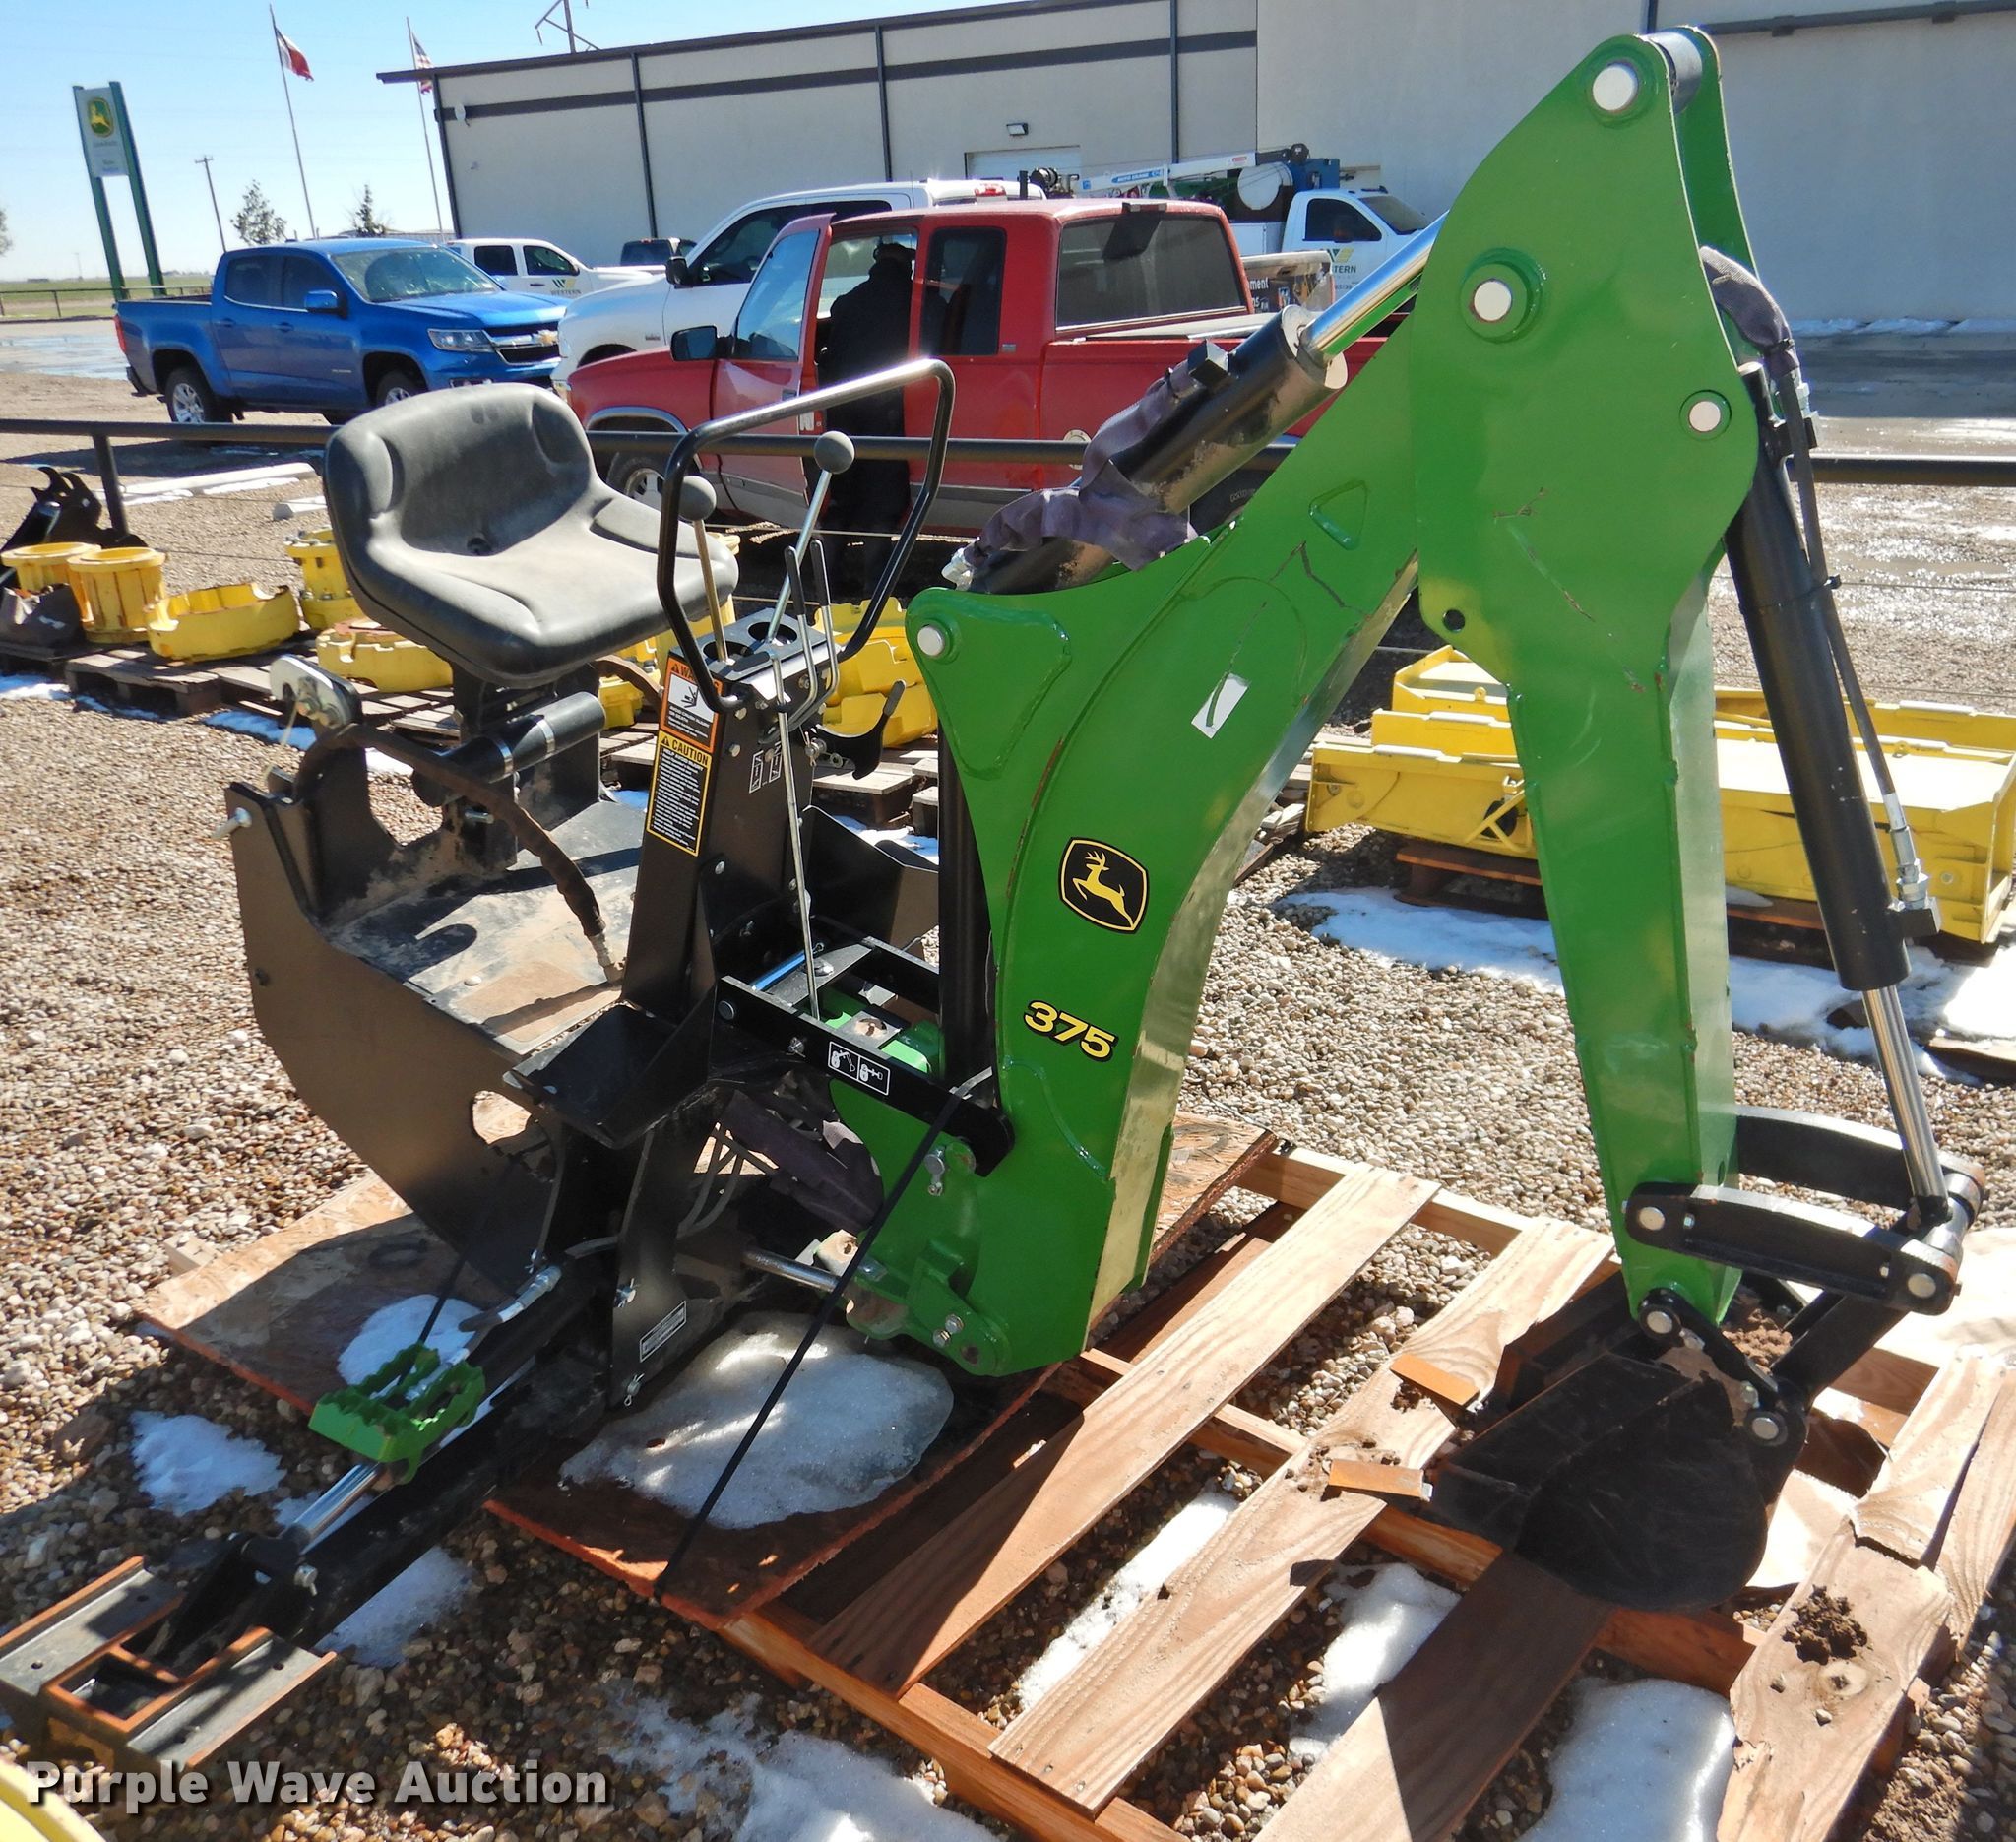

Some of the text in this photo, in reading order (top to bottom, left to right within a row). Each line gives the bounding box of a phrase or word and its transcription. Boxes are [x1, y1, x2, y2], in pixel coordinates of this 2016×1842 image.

[1249, 277, 1269, 290] ment
[672, 739, 708, 766] CAUTION
[1024, 1001, 1117, 1061] 375
